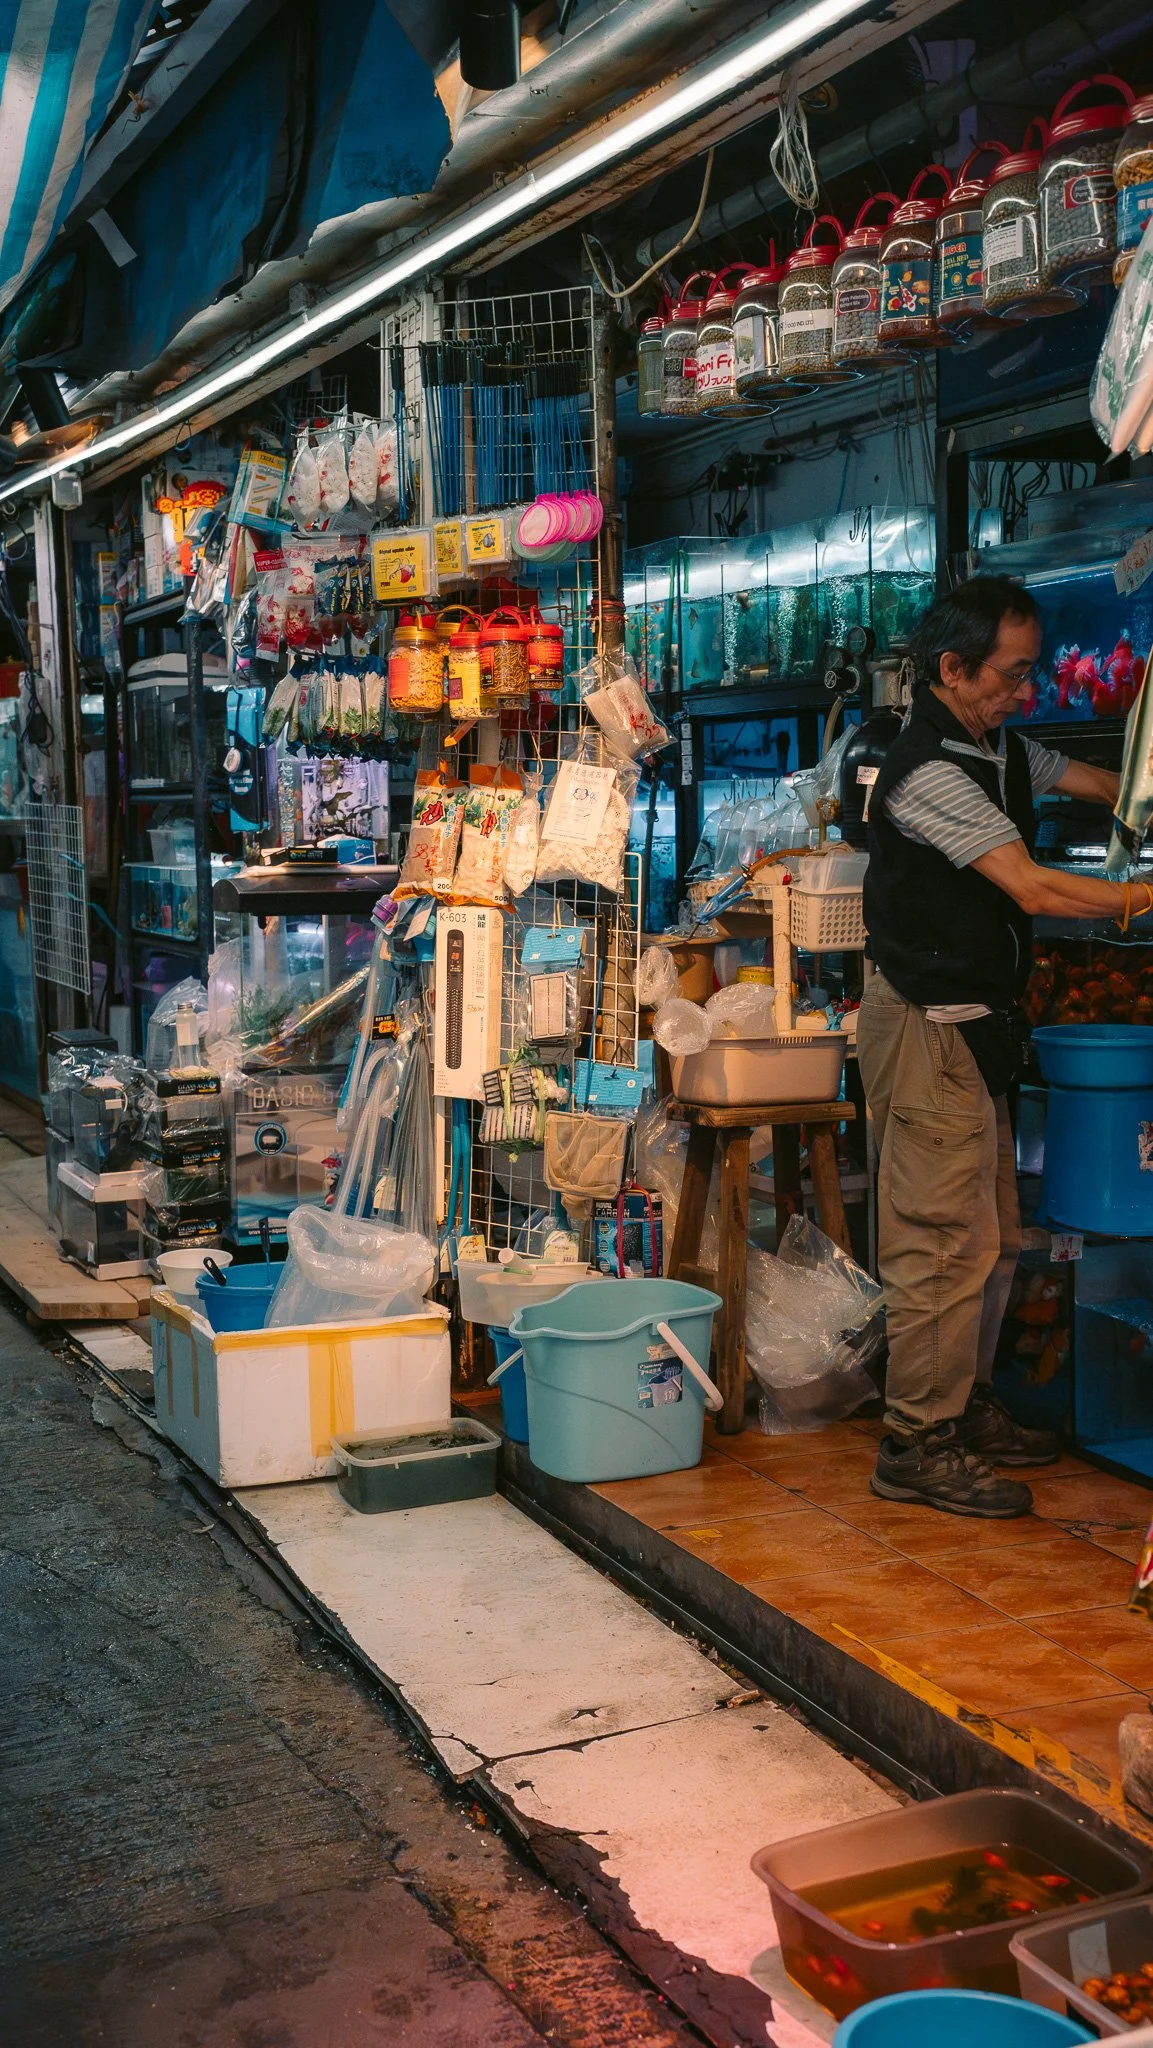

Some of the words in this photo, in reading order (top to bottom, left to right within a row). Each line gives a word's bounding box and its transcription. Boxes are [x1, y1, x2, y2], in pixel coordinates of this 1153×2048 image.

[439, 912, 467, 923] K-603
[252, 1084, 313, 1109] BASIC
[596, 1208, 630, 1218] CARBN
